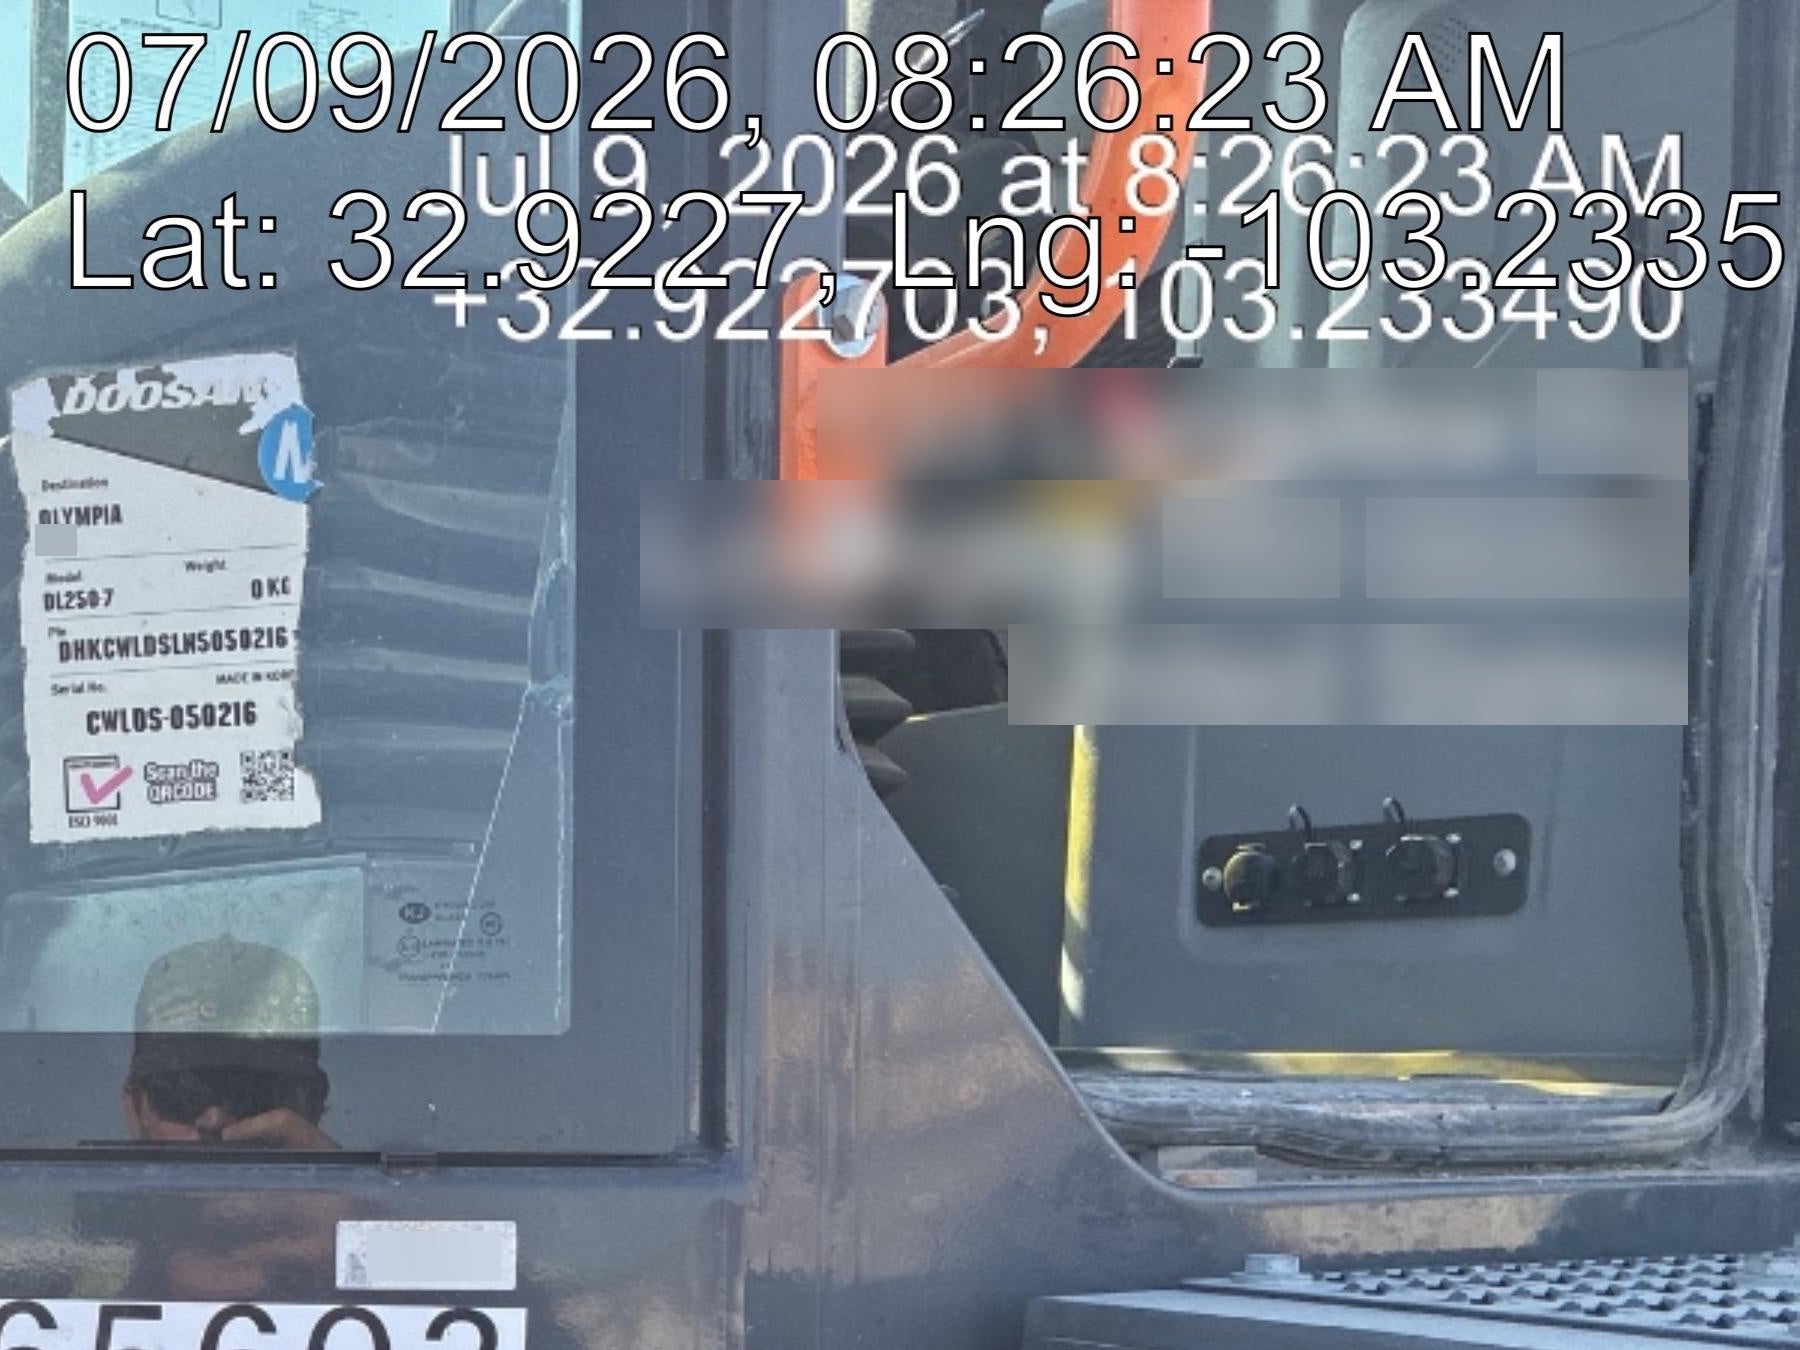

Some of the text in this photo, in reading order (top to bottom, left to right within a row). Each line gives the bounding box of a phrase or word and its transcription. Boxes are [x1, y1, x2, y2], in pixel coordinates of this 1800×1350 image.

[41, 477, 109, 492] Destination
[38, 504, 122, 526] OLYMPIA
[184, 559, 227, 573] Weight
[50, 681, 85, 697] Serial
[144, 758, 219, 785] Scan the
